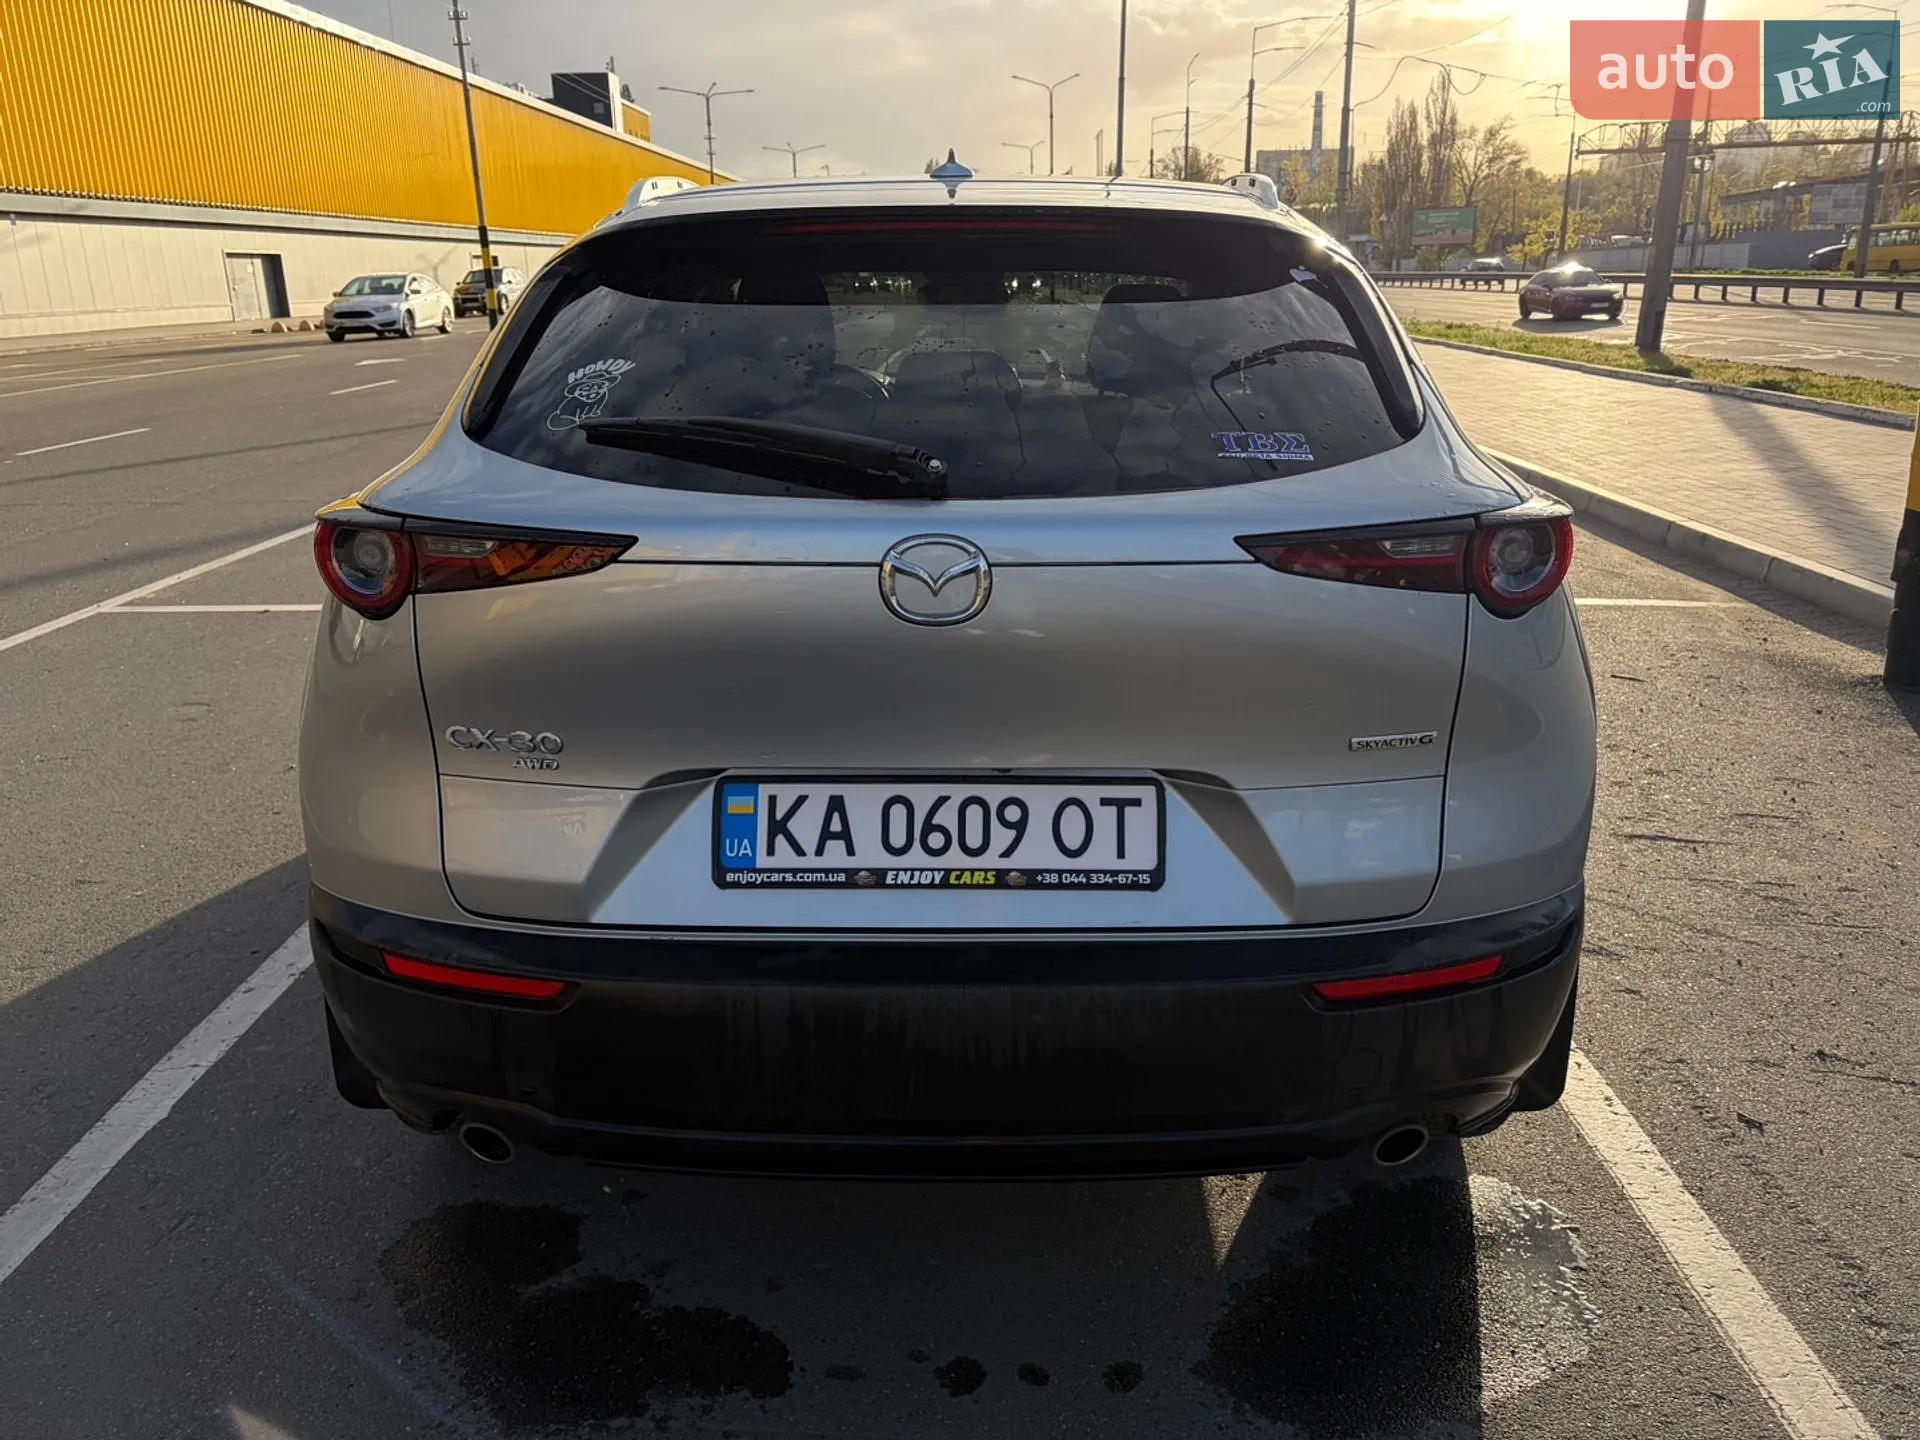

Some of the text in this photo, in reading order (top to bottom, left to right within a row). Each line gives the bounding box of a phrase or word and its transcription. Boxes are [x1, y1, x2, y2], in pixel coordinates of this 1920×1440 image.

[567, 358, 637, 383] HOWDY
[445, 725, 564, 755] CX-30
[512, 757, 560, 771] AWD
[766, 794, 1142, 860] KA 0609 OT
[725, 838, 752, 857] UA
[726, 870, 846, 884] enjoycars.com.ua
[885, 870, 997, 885] ENJOY CARS
[1036, 873, 1150, 885] +38 044 334-67-15
